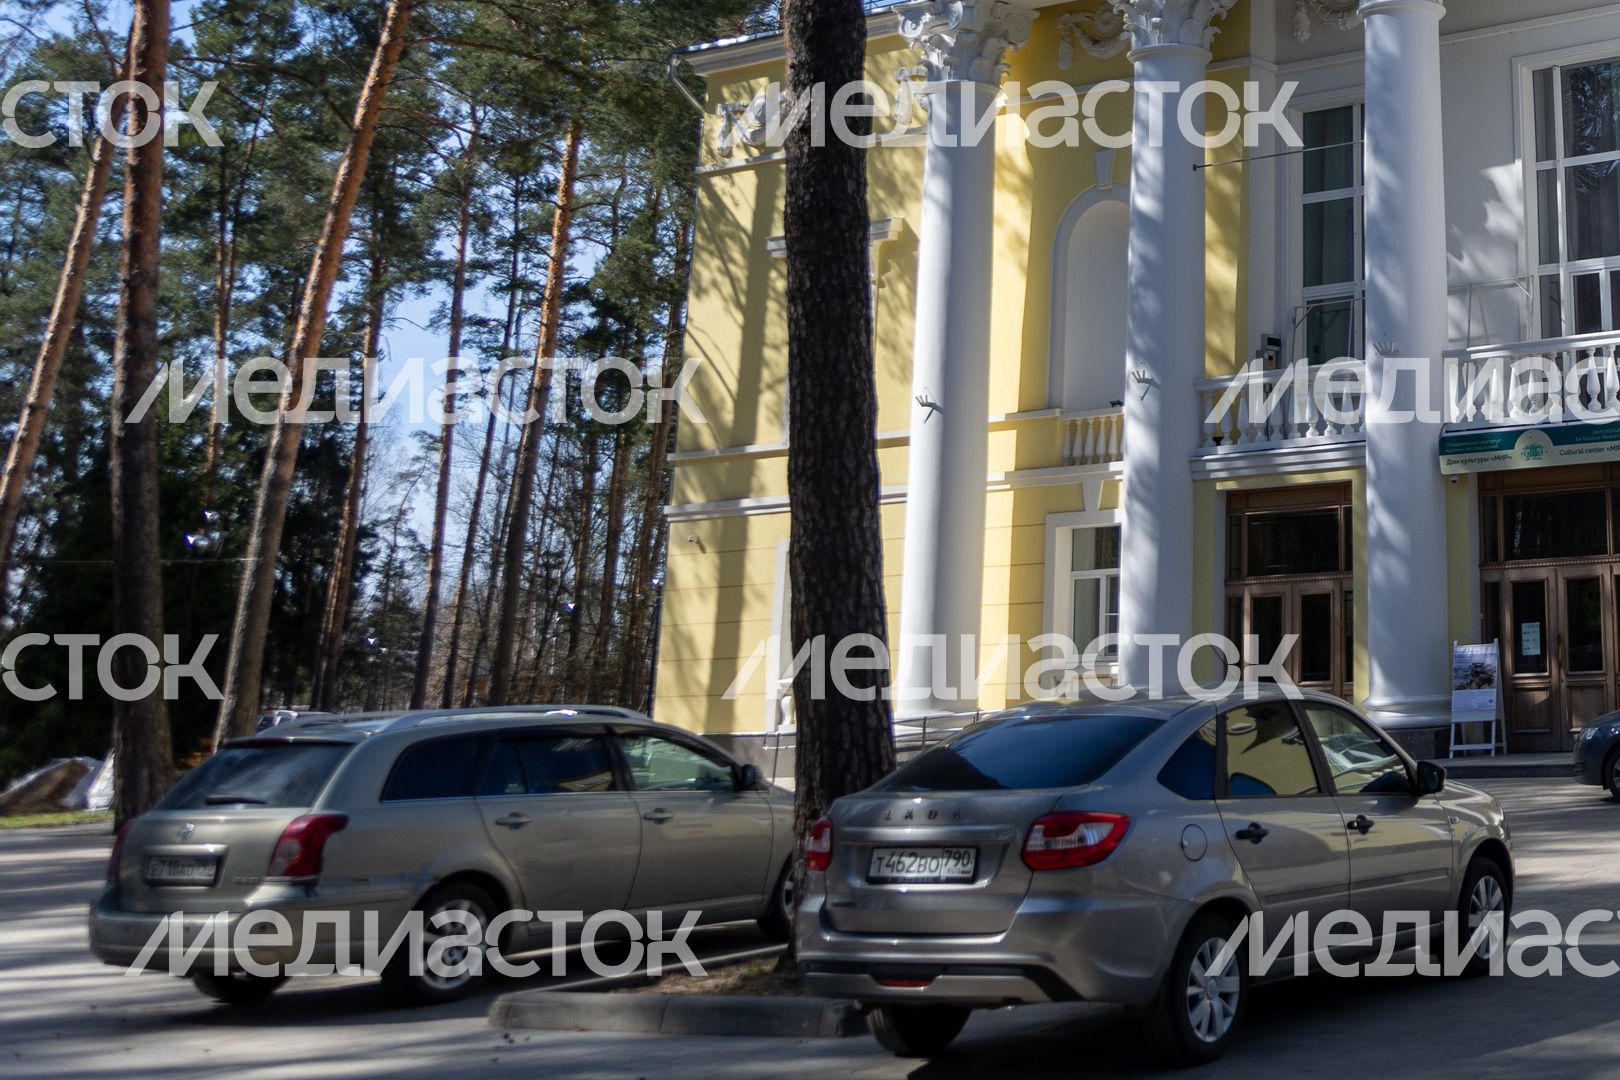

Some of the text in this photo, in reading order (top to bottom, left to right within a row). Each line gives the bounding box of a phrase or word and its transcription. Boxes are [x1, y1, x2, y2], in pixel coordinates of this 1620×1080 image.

[1559, 448, 1584, 456] Cultural
[1460, 457, 1489, 465] культуры
[885, 809, 962, 821] LADA
[944, 849, 971, 867] 790
